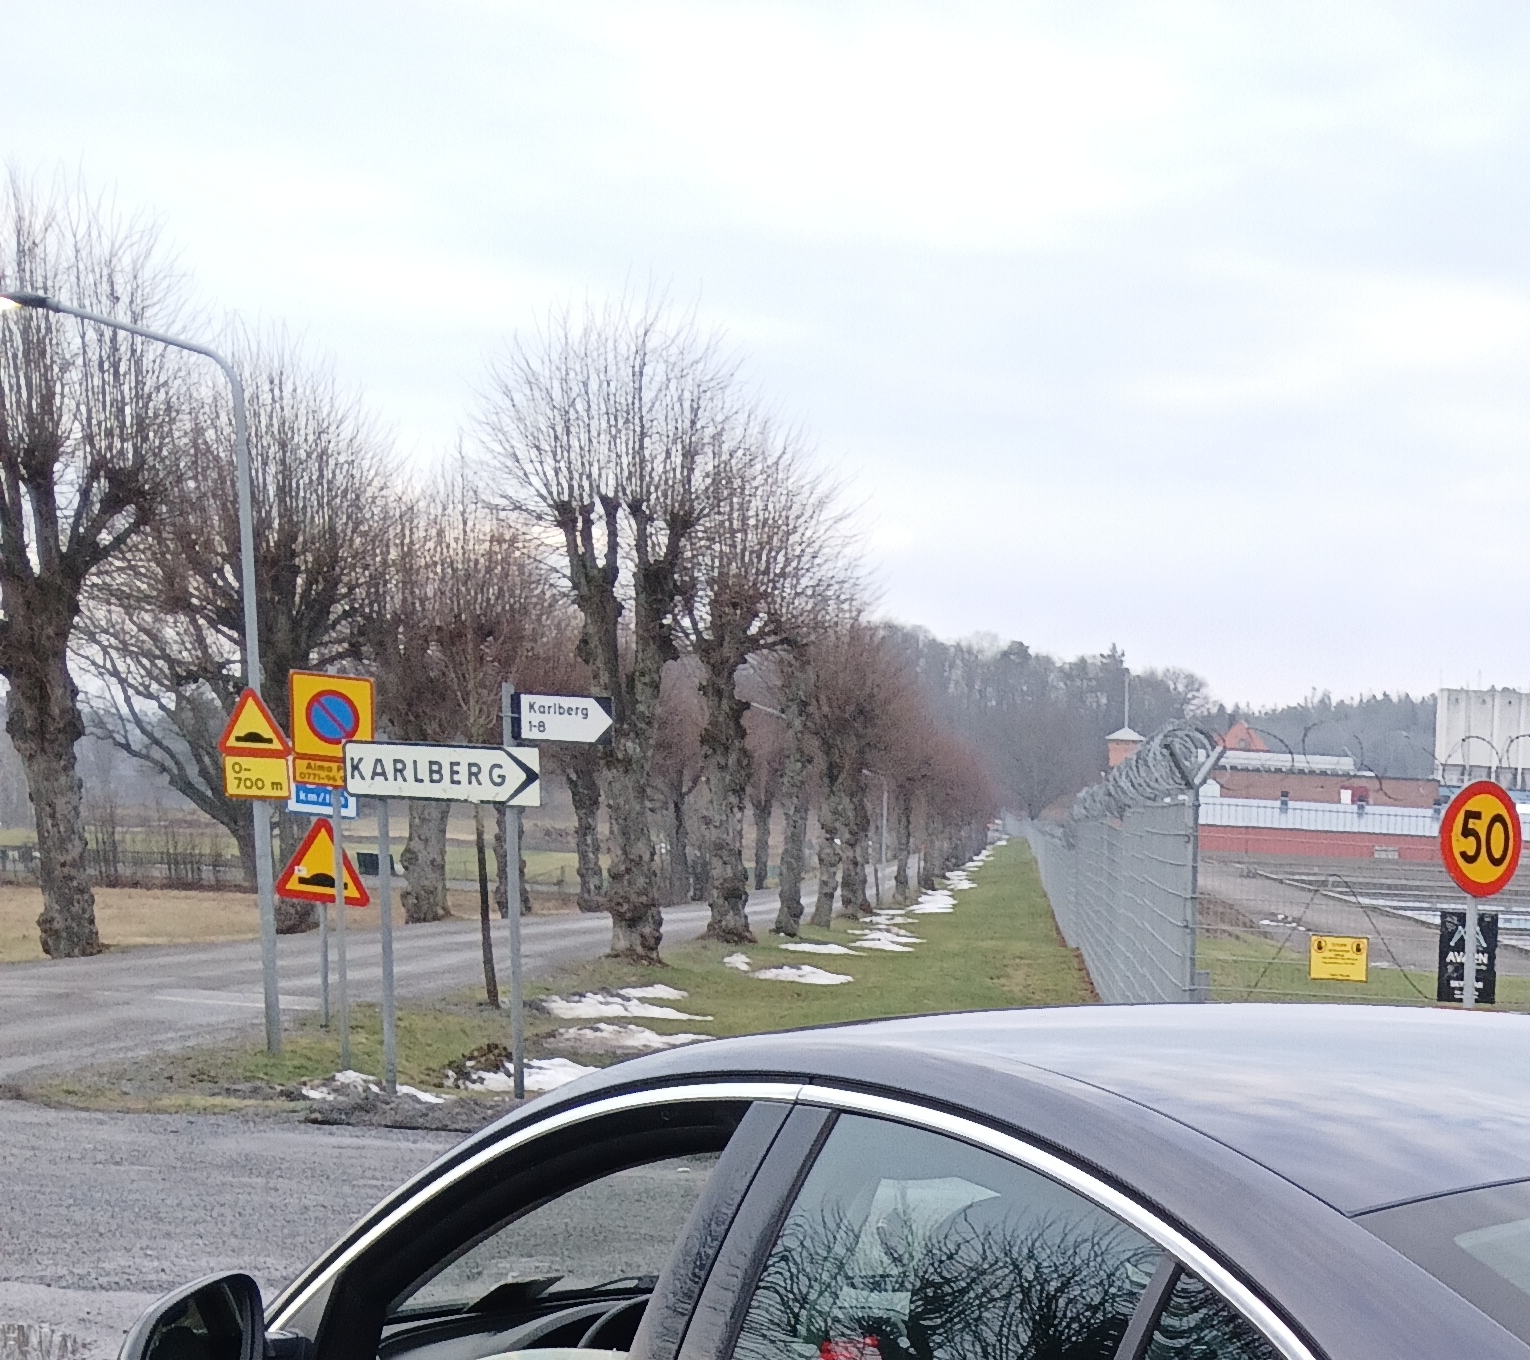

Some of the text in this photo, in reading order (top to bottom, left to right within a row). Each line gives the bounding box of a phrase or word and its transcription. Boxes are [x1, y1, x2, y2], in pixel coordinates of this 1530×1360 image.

[528, 701, 589, 720] Karlberg
[528, 720, 546, 733] 1-8
[231, 761, 251, 774] 0-
[350, 757, 507, 787] KARLBERG
[233, 776, 283, 791] 700 m
[1459, 809, 1510, 867] 50
[1445, 951, 1489, 965] AVN
